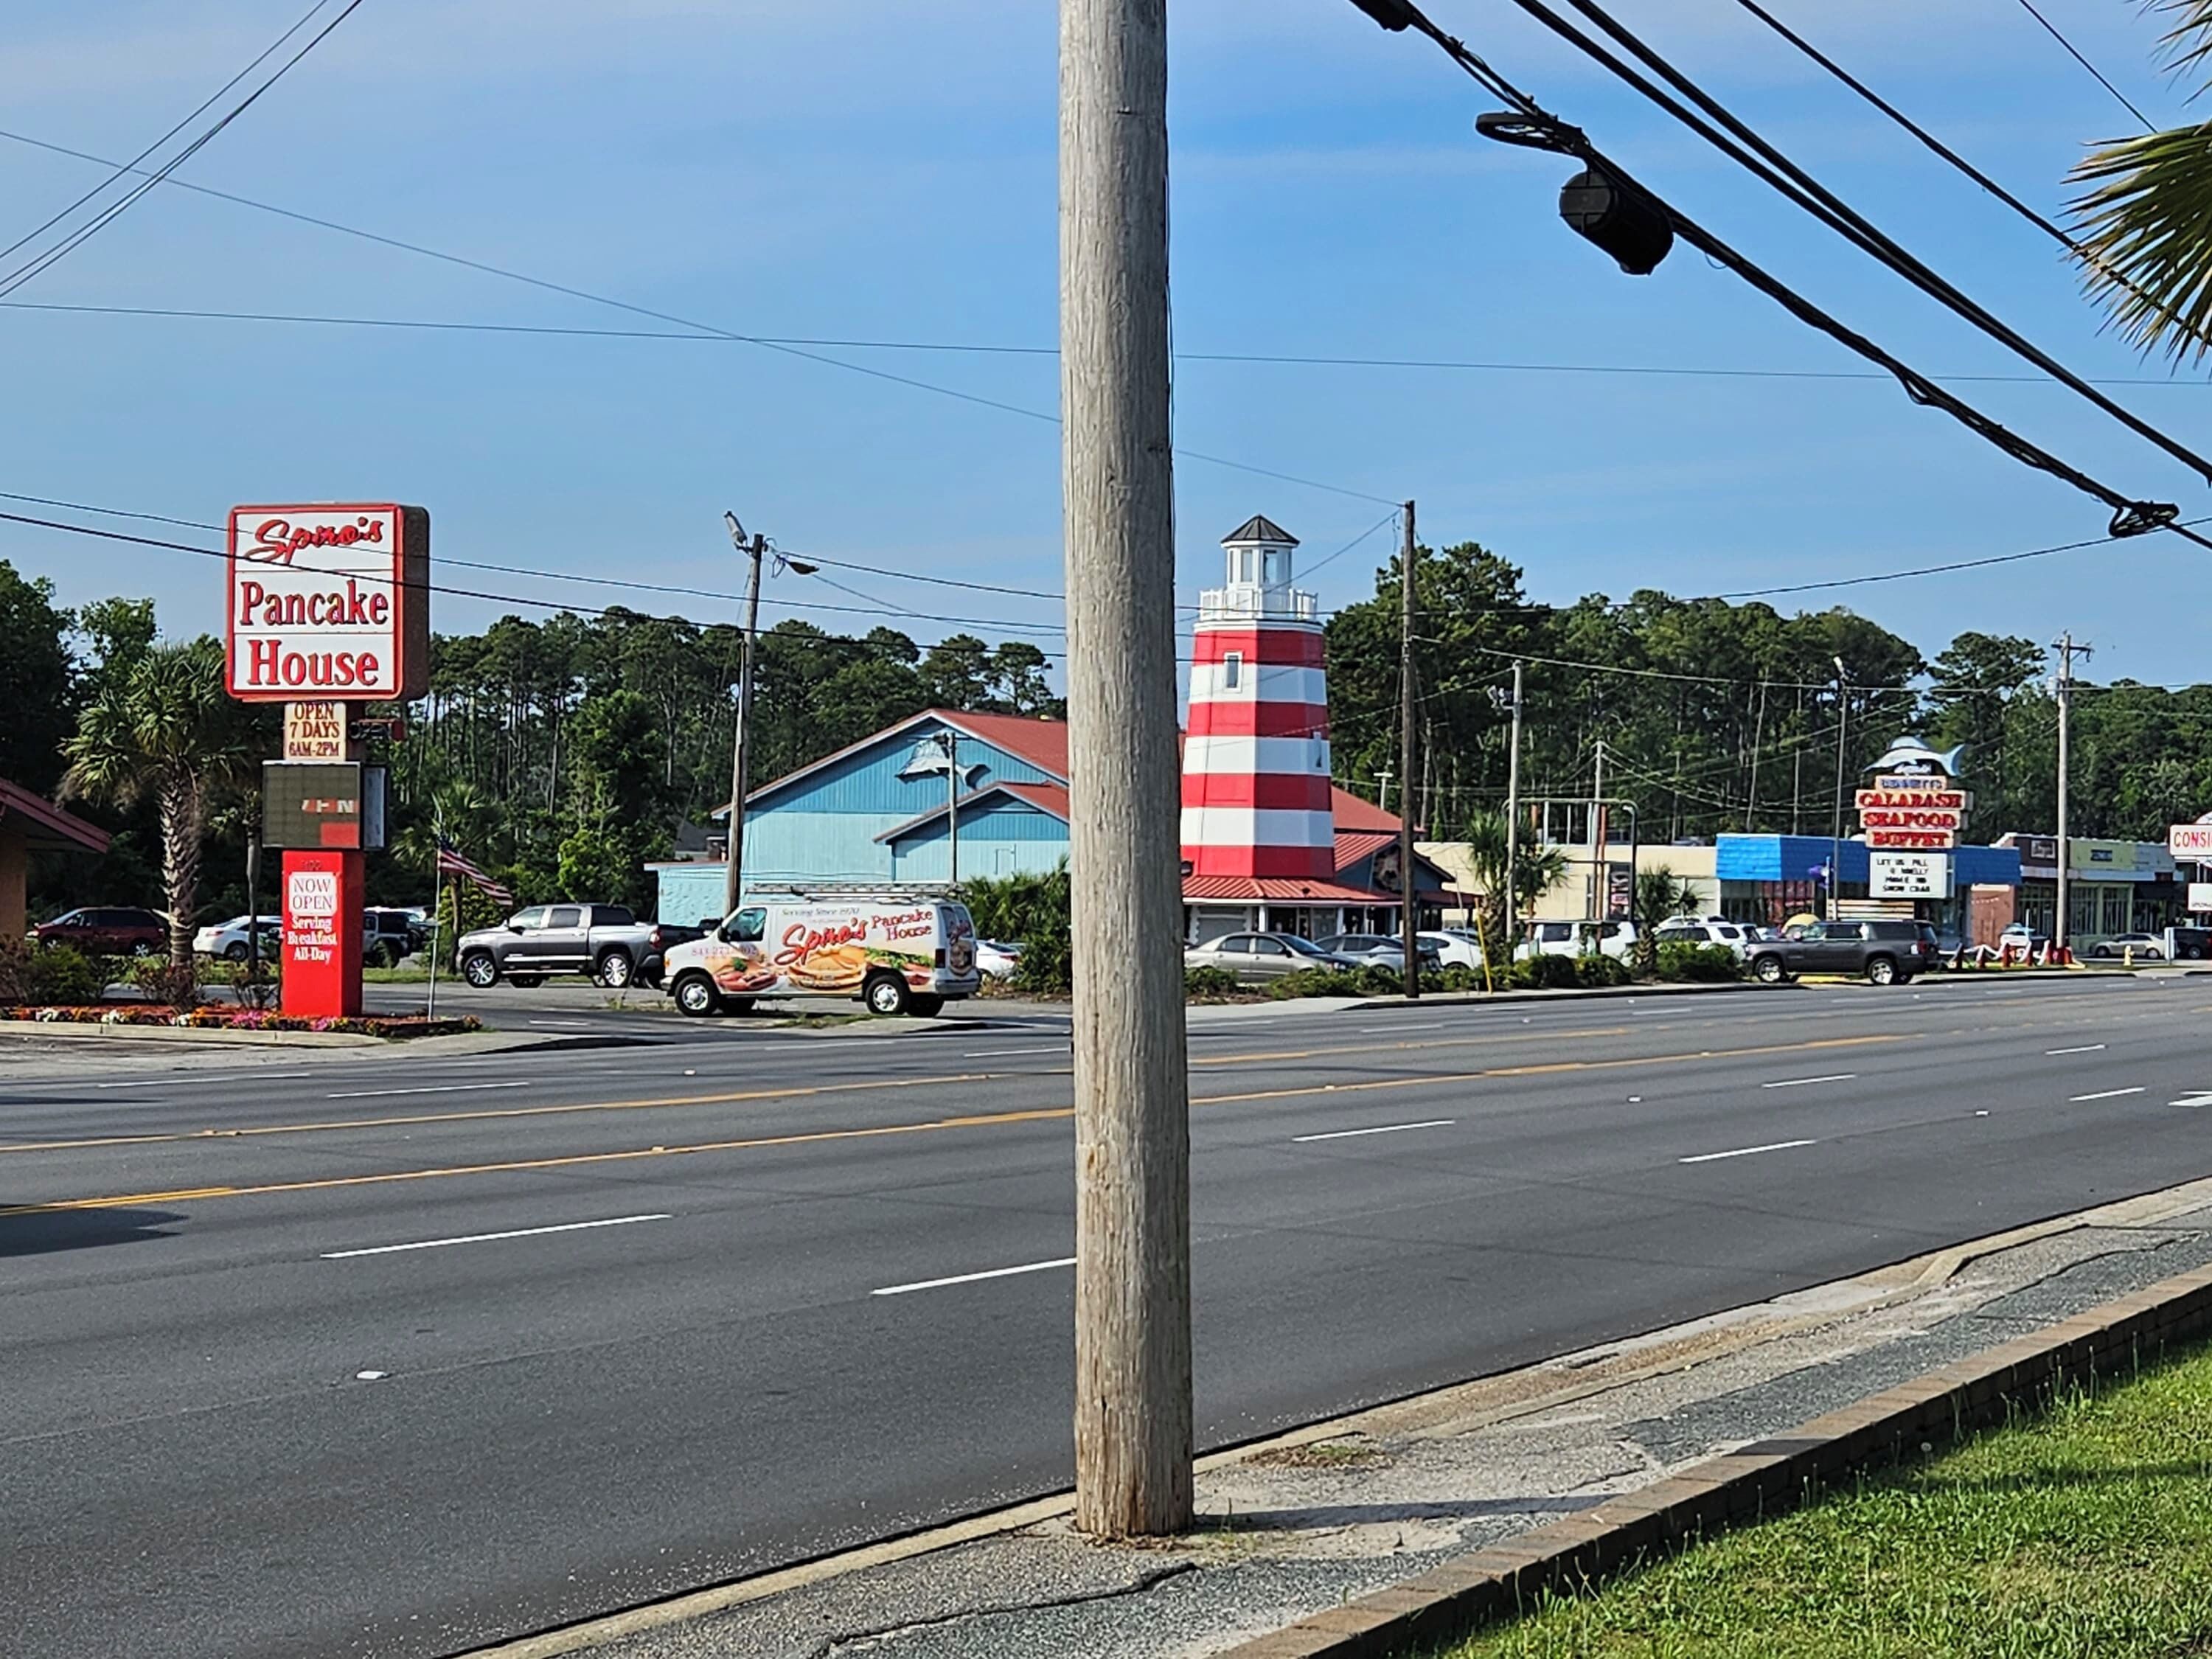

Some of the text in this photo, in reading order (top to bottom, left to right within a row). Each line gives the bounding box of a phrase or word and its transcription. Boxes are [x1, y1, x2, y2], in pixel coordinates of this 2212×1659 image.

[244, 516, 384, 565] Spiro's
[240, 579, 389, 626] Pancake
[247, 639, 379, 686] House
[294, 701, 334, 720] OPEN
[290, 721, 341, 739] 7 DAYS
[2174, 831, 2212, 848] CONSI
[293, 877, 331, 893] NOW
[292, 894, 333, 910] OPEN
[291, 916, 333, 933] Serving
[872, 908, 933, 928] Pancake
[287, 931, 337, 945] Breakfast
[886, 925, 933, 941] House
